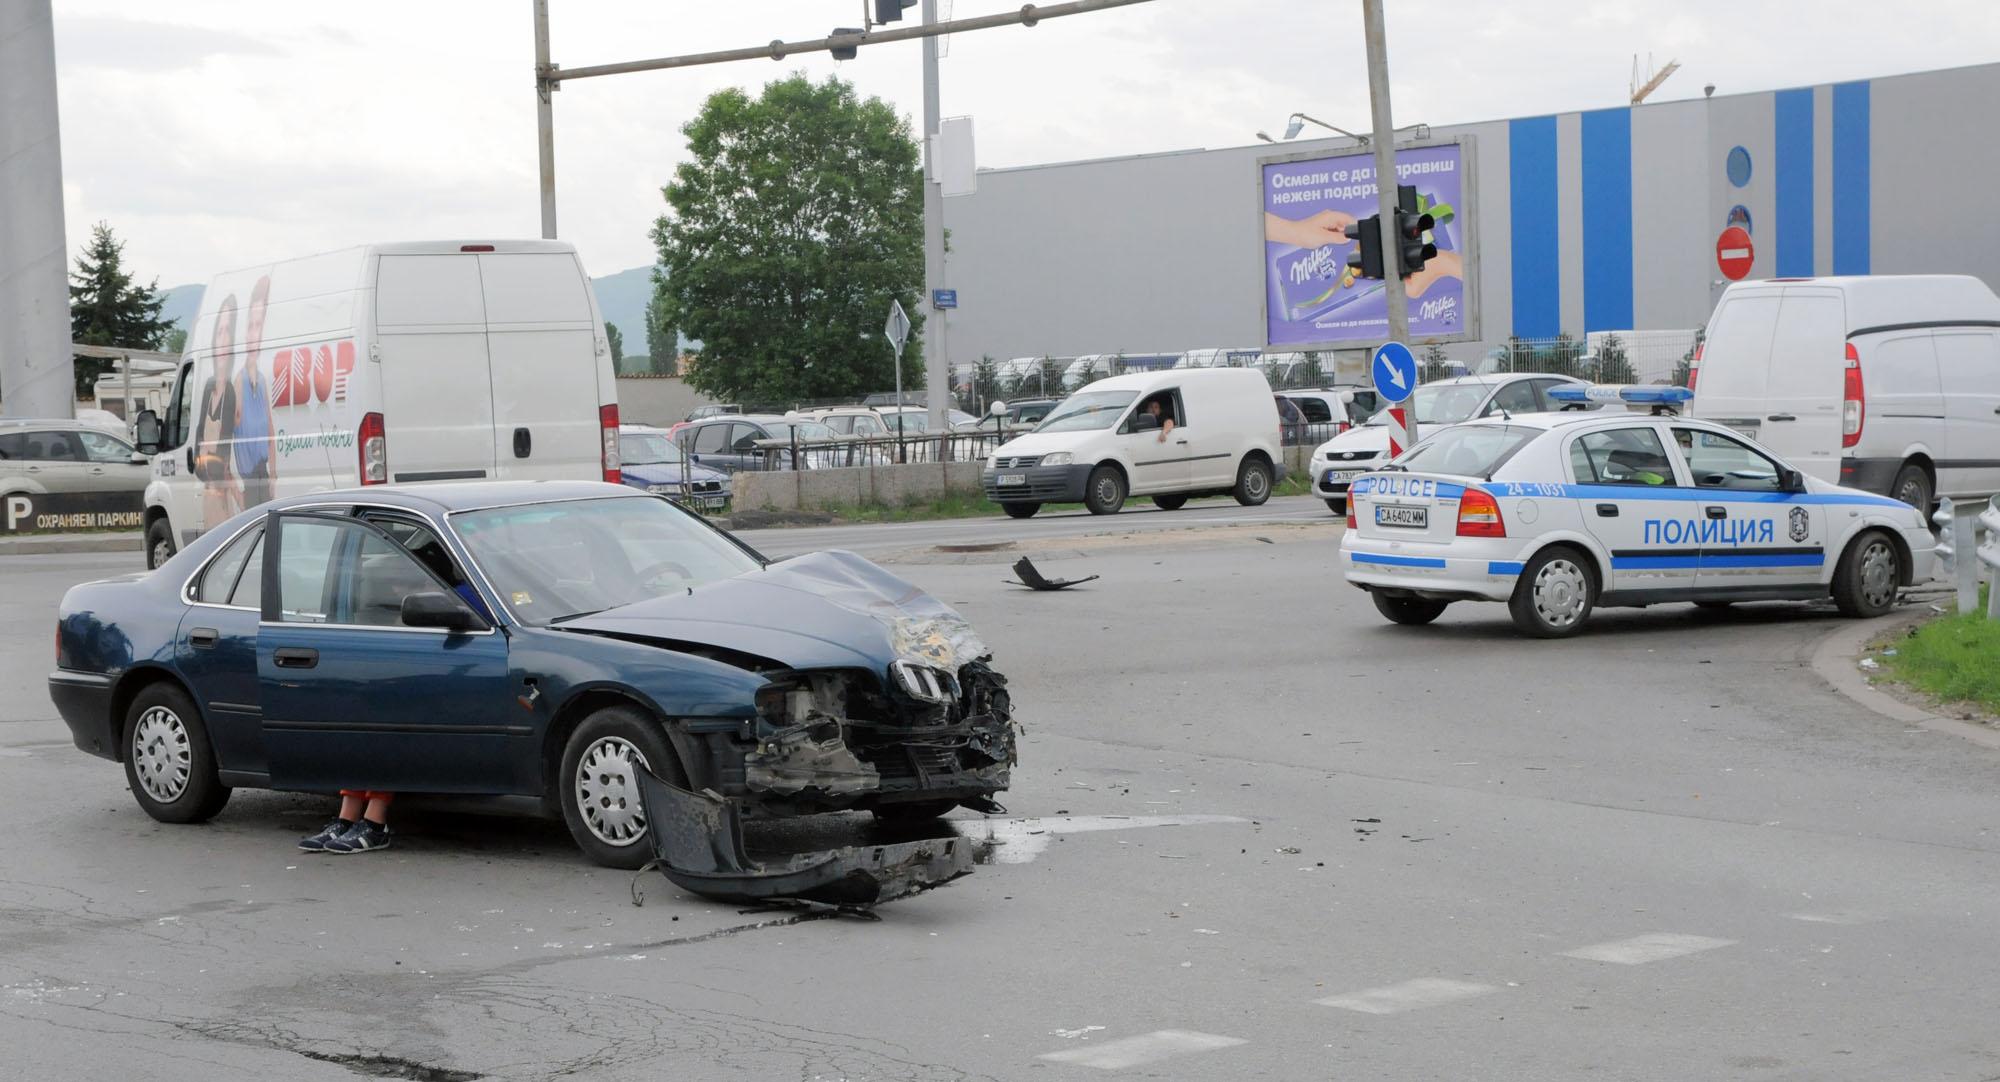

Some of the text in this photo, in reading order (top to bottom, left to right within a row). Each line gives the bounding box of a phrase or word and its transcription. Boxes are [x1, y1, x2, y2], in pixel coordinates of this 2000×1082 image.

[1272, 172, 1328, 188] Осмели
[1332, 170, 1348, 181] се
[1351, 168, 1370, 182] да
[1273, 183, 1378, 204] нежен подаръ
[1290, 246, 1332, 284] Milka
[1420, 296, 1456, 319] Milka
[272, 341, 355, 408] ЯВОР
[1368, 476, 1433, 497] POLICE
[1505, 482, 1524, 496] 24
[1534, 482, 1566, 497] 1031
[7, 496, 33, 530] P
[37, 512, 96, 529] ОХРАНЯЕМ
[1644, 518, 1774, 547] ПОЛИЦИЯ
